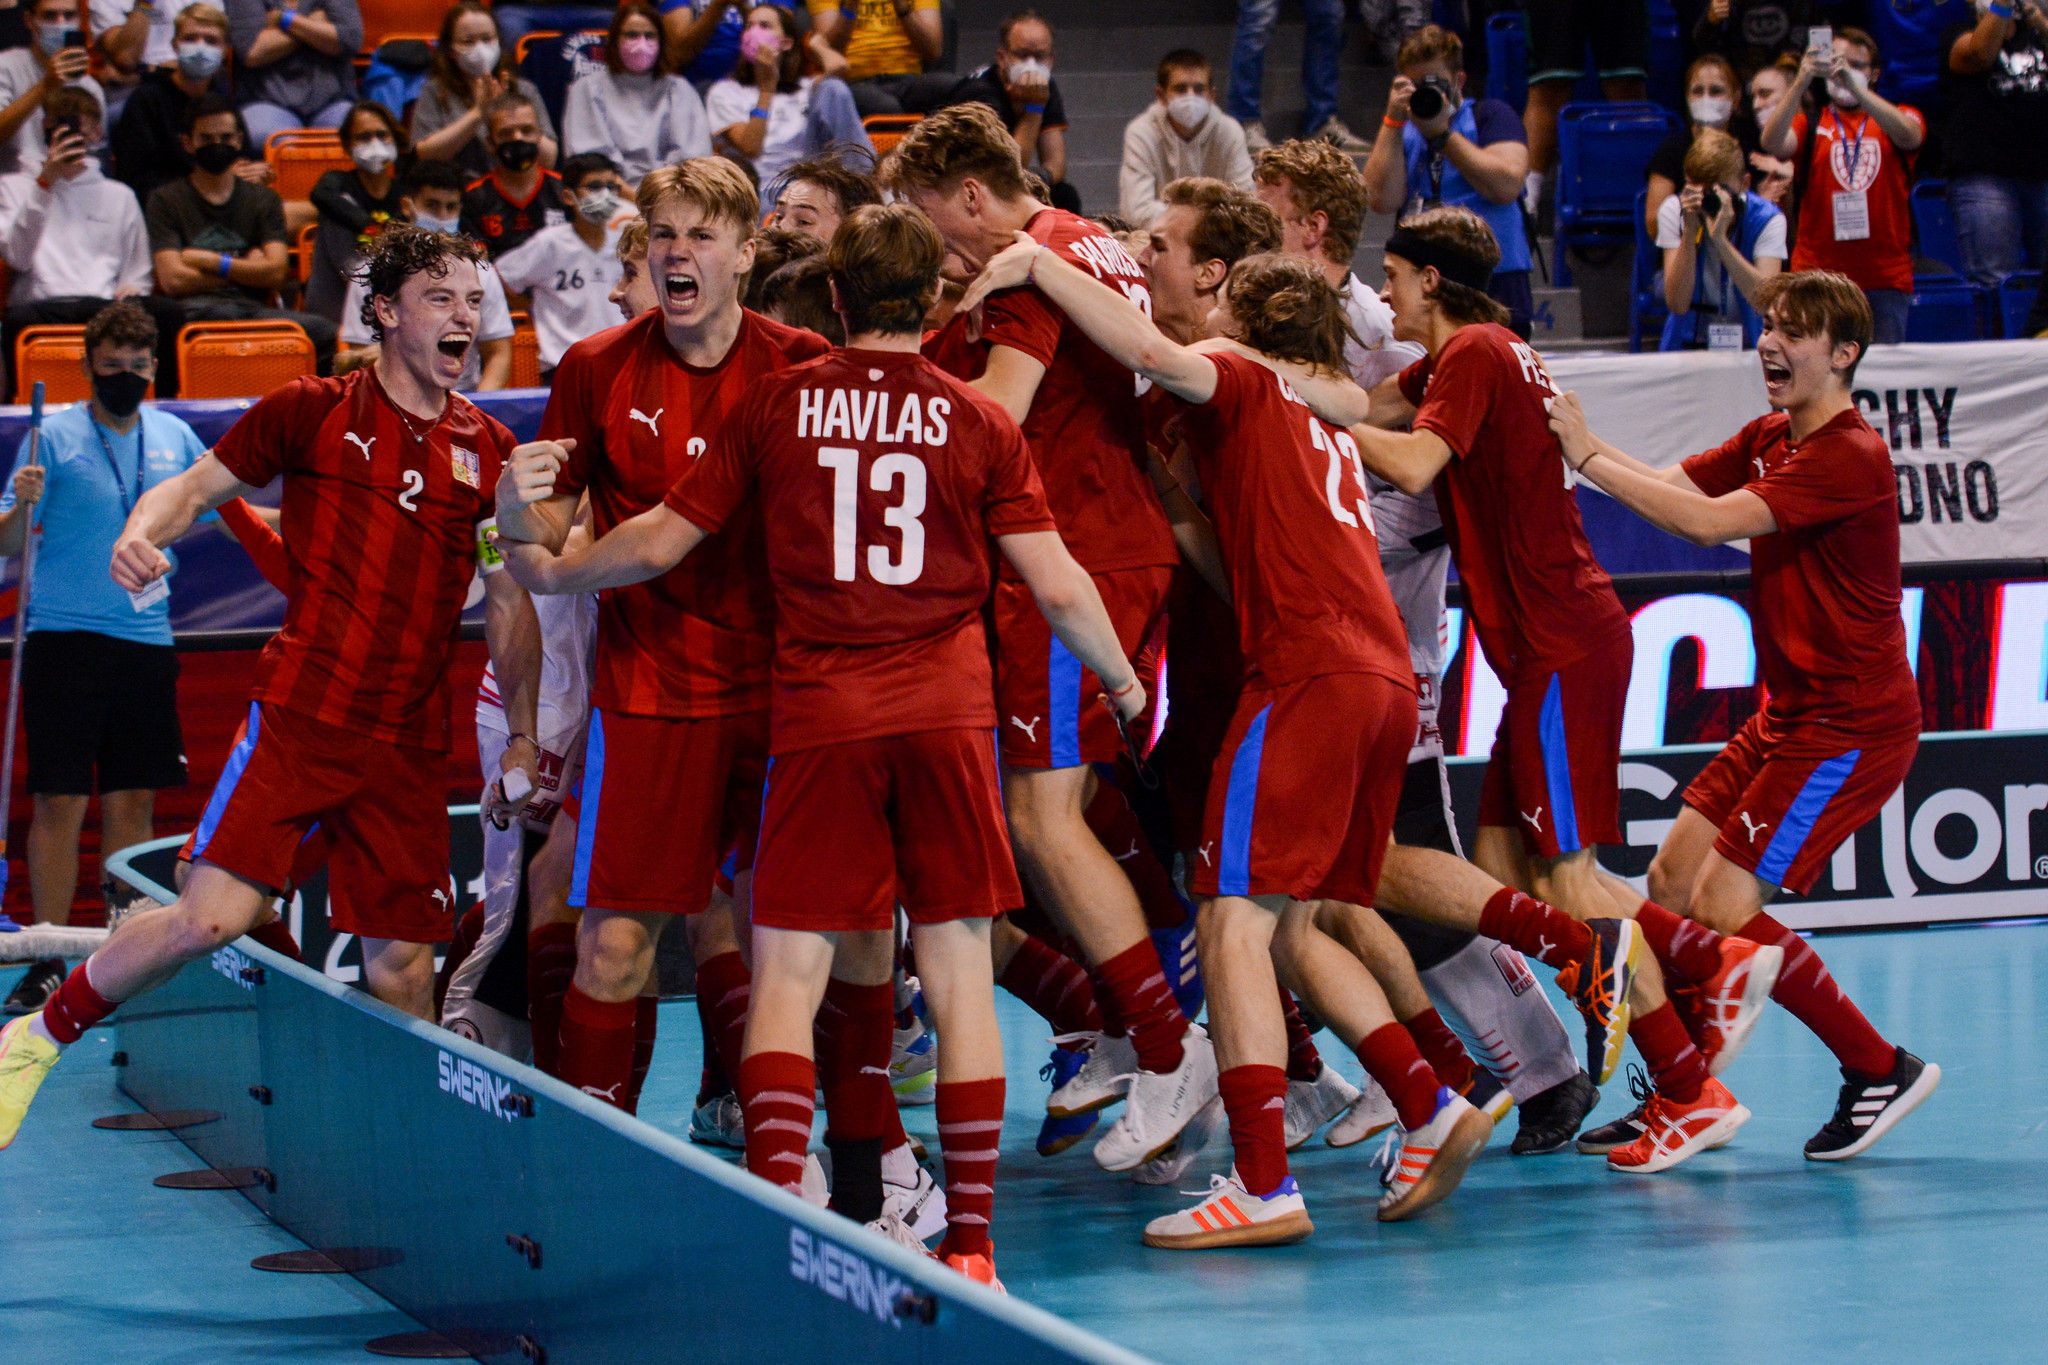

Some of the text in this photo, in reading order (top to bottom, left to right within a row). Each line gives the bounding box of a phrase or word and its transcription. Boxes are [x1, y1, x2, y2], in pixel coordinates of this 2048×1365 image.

[556, 269, 585, 291] 26
[797, 388, 951, 447] HAVLAS
[398, 470, 424, 512] 2
[817, 446, 927, 586] 13
